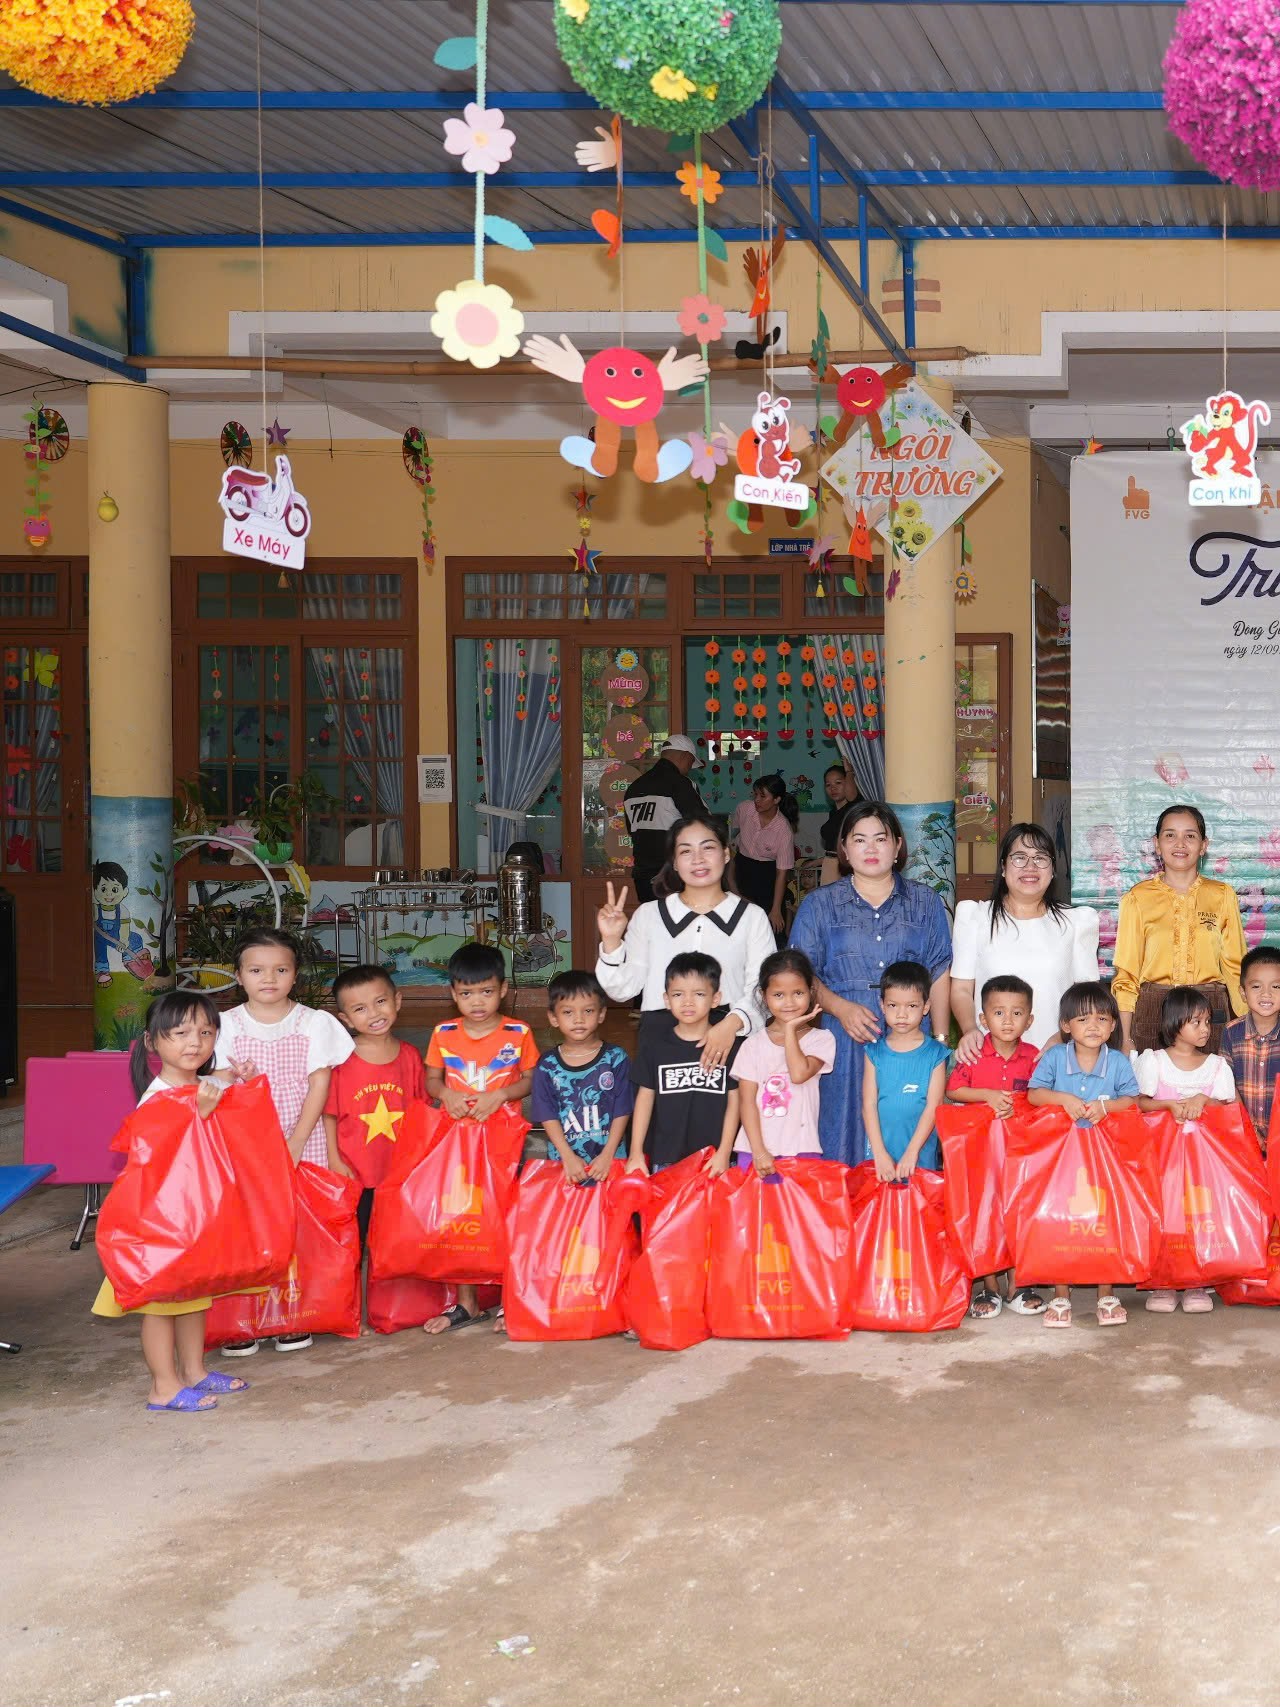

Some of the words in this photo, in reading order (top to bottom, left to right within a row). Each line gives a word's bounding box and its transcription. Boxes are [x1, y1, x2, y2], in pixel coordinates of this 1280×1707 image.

[854, 464, 976, 496] TRƯỜNG
[742, 483, 769, 499] Con
[1193, 487, 1224, 500] Con
[1125, 510, 1150, 520] FVG
[234, 527, 253, 547] Xe
[258, 534, 290, 560] Máy
[617, 730, 633, 742] bé
[666, 1076, 719, 1089] BACK
[440, 1219, 481, 1236] FVG
[1070, 1221, 1107, 1237] FVG
[560, 1280, 598, 1297] FVG
[758, 1279, 793, 1296] FVG
